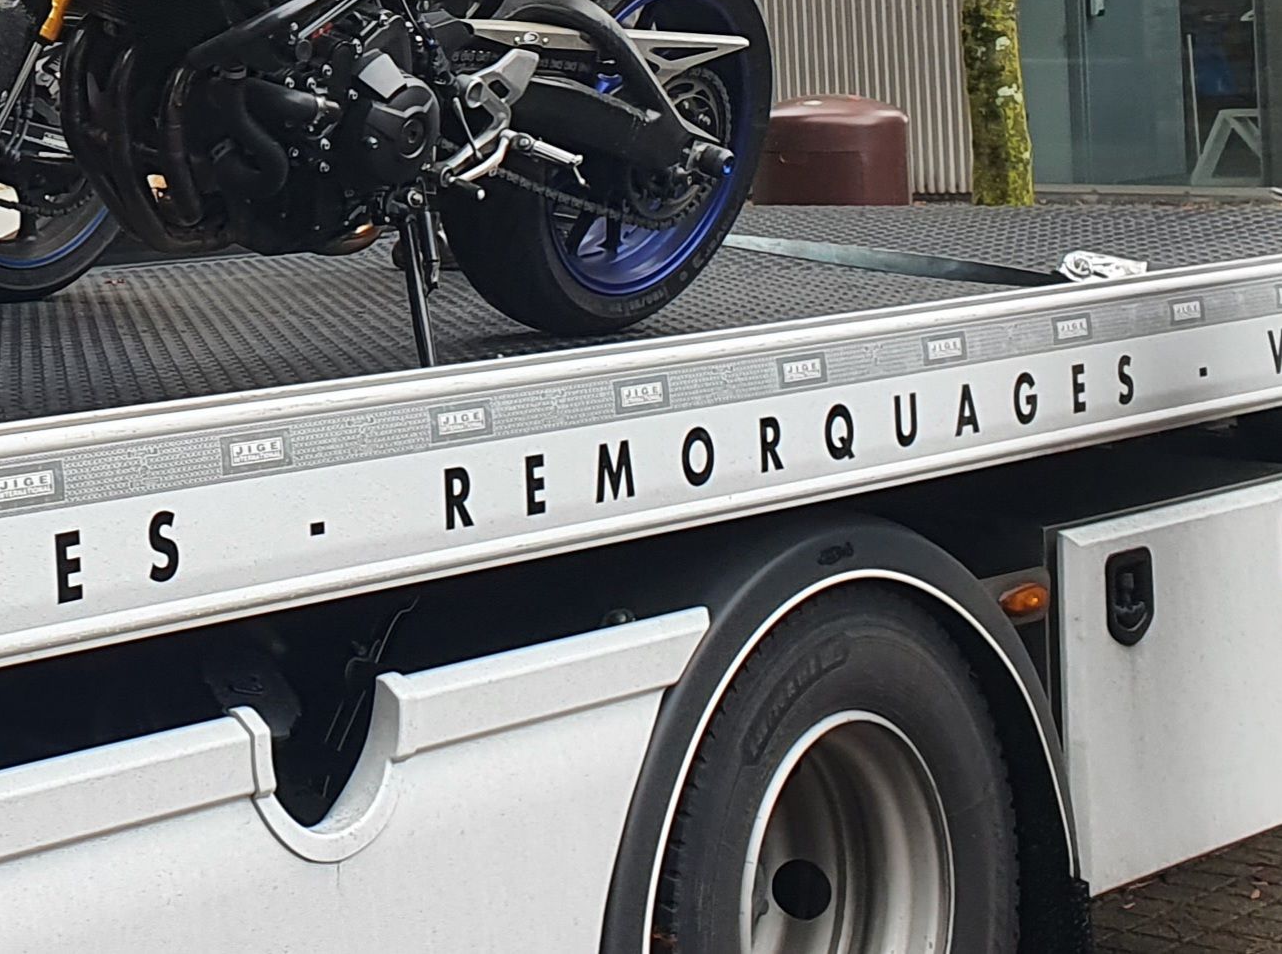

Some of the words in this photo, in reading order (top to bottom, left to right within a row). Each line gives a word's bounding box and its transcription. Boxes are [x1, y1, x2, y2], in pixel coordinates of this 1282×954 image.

[235, 441, 279, 456] JIGE
[444, 355, 1134, 530] REMORQUAGES
[0, 474, 49, 490] JIGE
